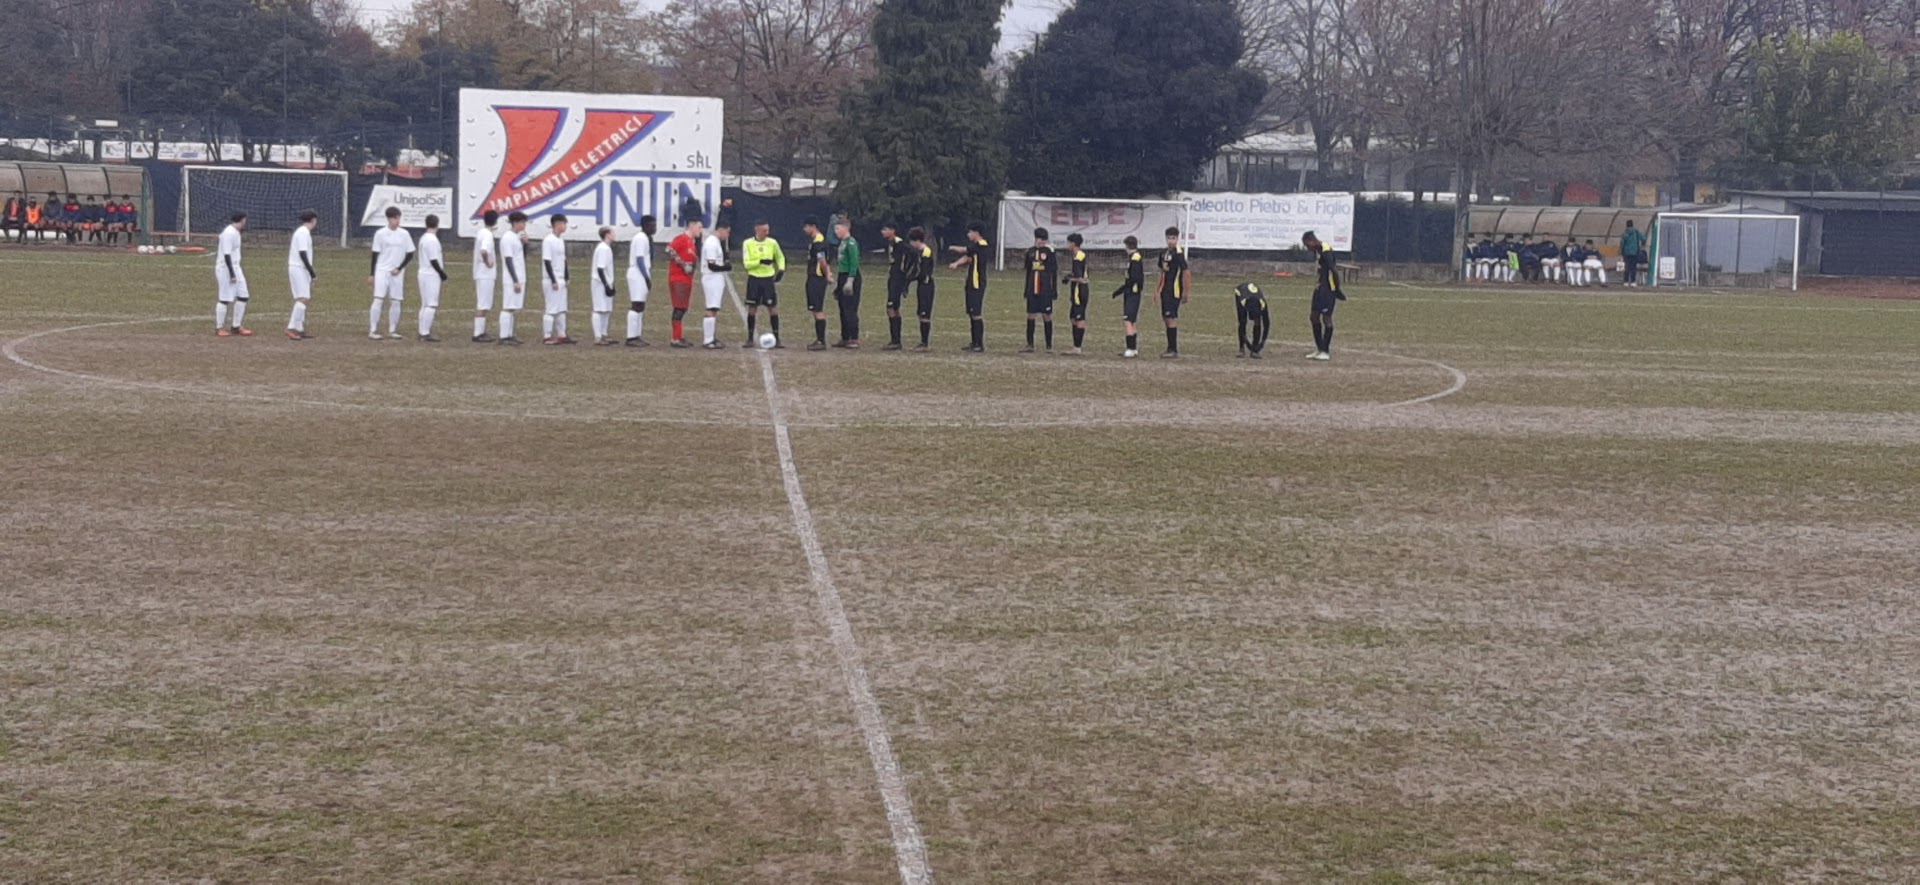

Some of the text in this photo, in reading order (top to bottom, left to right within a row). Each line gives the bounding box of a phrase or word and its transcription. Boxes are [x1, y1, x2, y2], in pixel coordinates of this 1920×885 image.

[490, 115, 643, 212] IMPIANTI ELETTRICI
[687, 154, 712, 169] SRL
[1249, 198, 1291, 214] Pietro
[1297, 199, 1310, 214] &
[1315, 199, 1352, 217] Figlio
